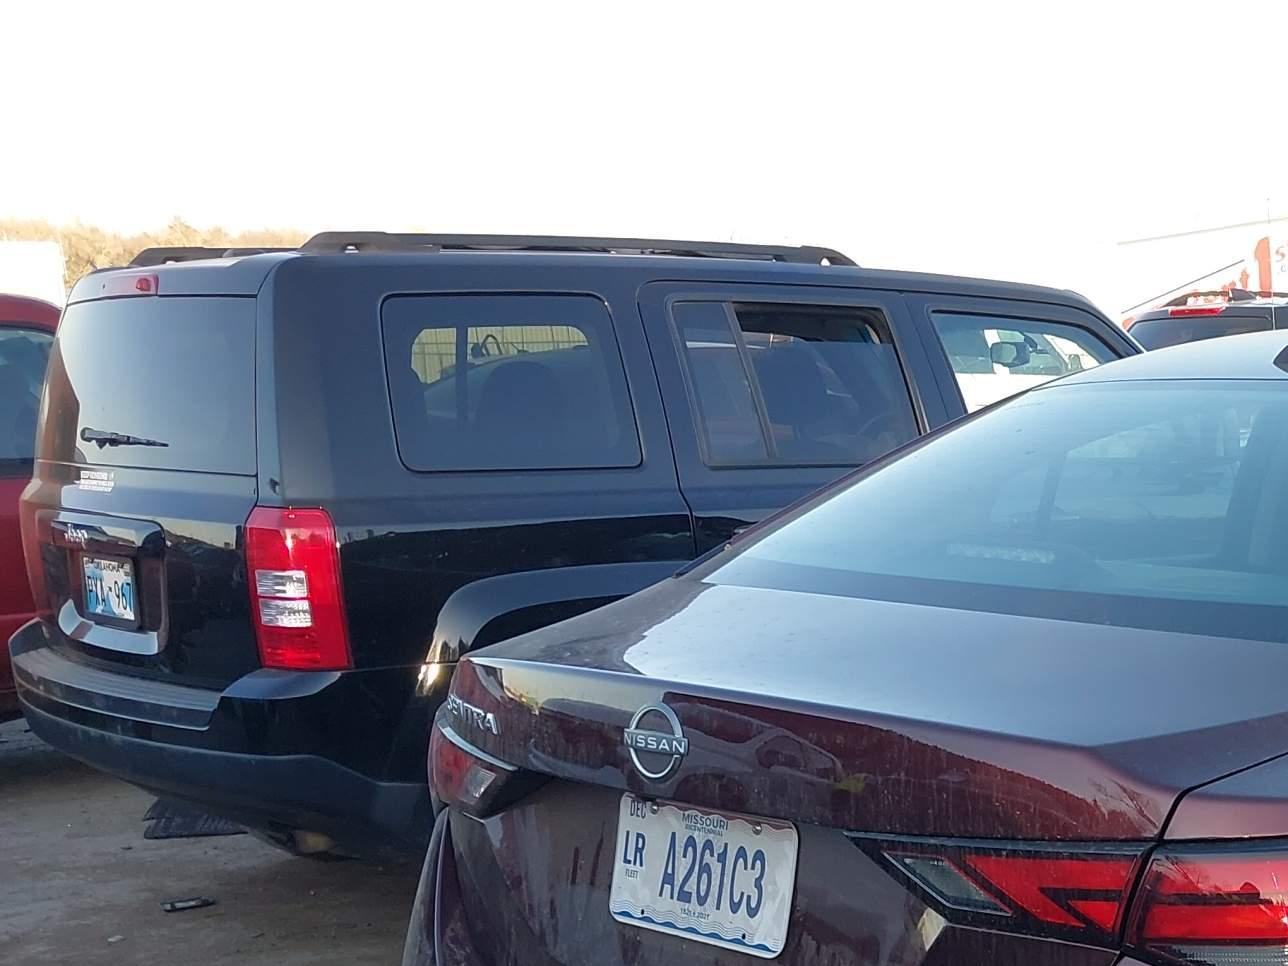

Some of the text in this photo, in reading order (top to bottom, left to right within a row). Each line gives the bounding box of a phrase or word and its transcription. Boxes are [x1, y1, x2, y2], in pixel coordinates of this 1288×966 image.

[447, 694, 498, 735] SENTRA
[624, 732, 686, 754] NISSAN
[629, 799, 647, 820] DEC
[681, 812, 729, 831] MISSOURI
[622, 830, 646, 867] LR
[658, 831, 766, 918] A261C3
